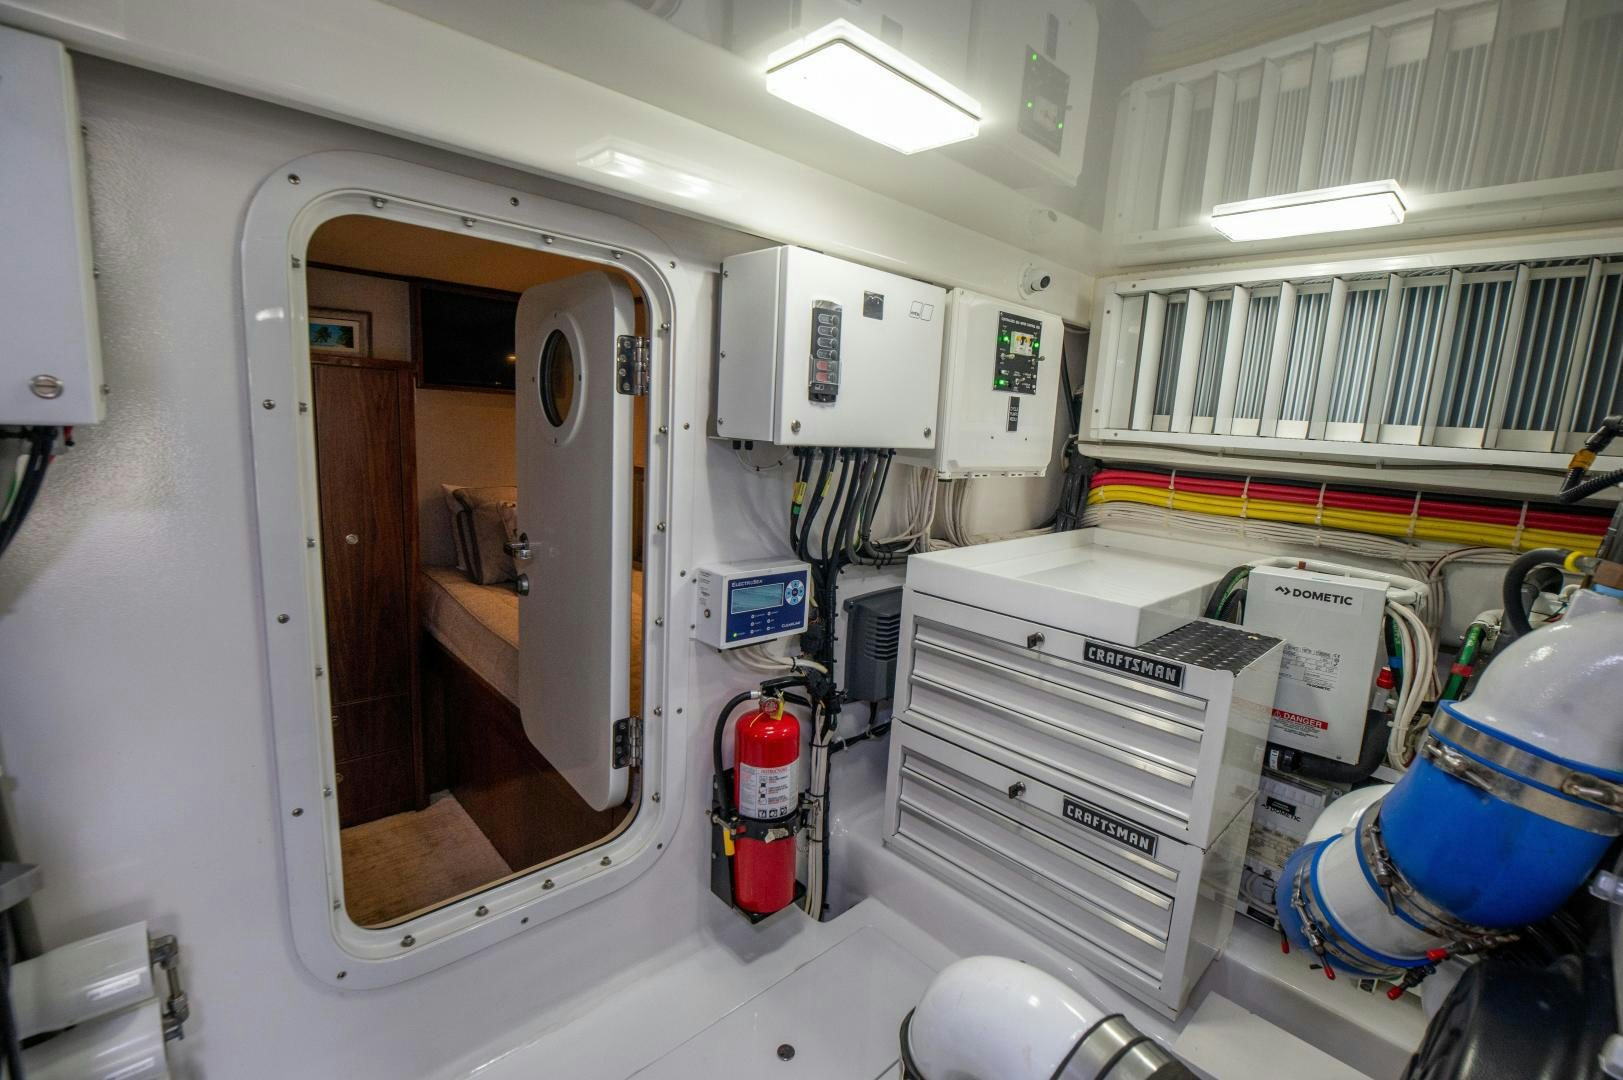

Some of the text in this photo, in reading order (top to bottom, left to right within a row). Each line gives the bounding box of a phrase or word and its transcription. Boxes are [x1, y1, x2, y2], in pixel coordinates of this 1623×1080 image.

[1292, 588, 1353, 606] DOMETIC
[1088, 646, 1177, 682] CRAFTSMAN
[1283, 712, 1322, 729] DANGER
[1066, 804, 1150, 850] CRAFTSMAN
